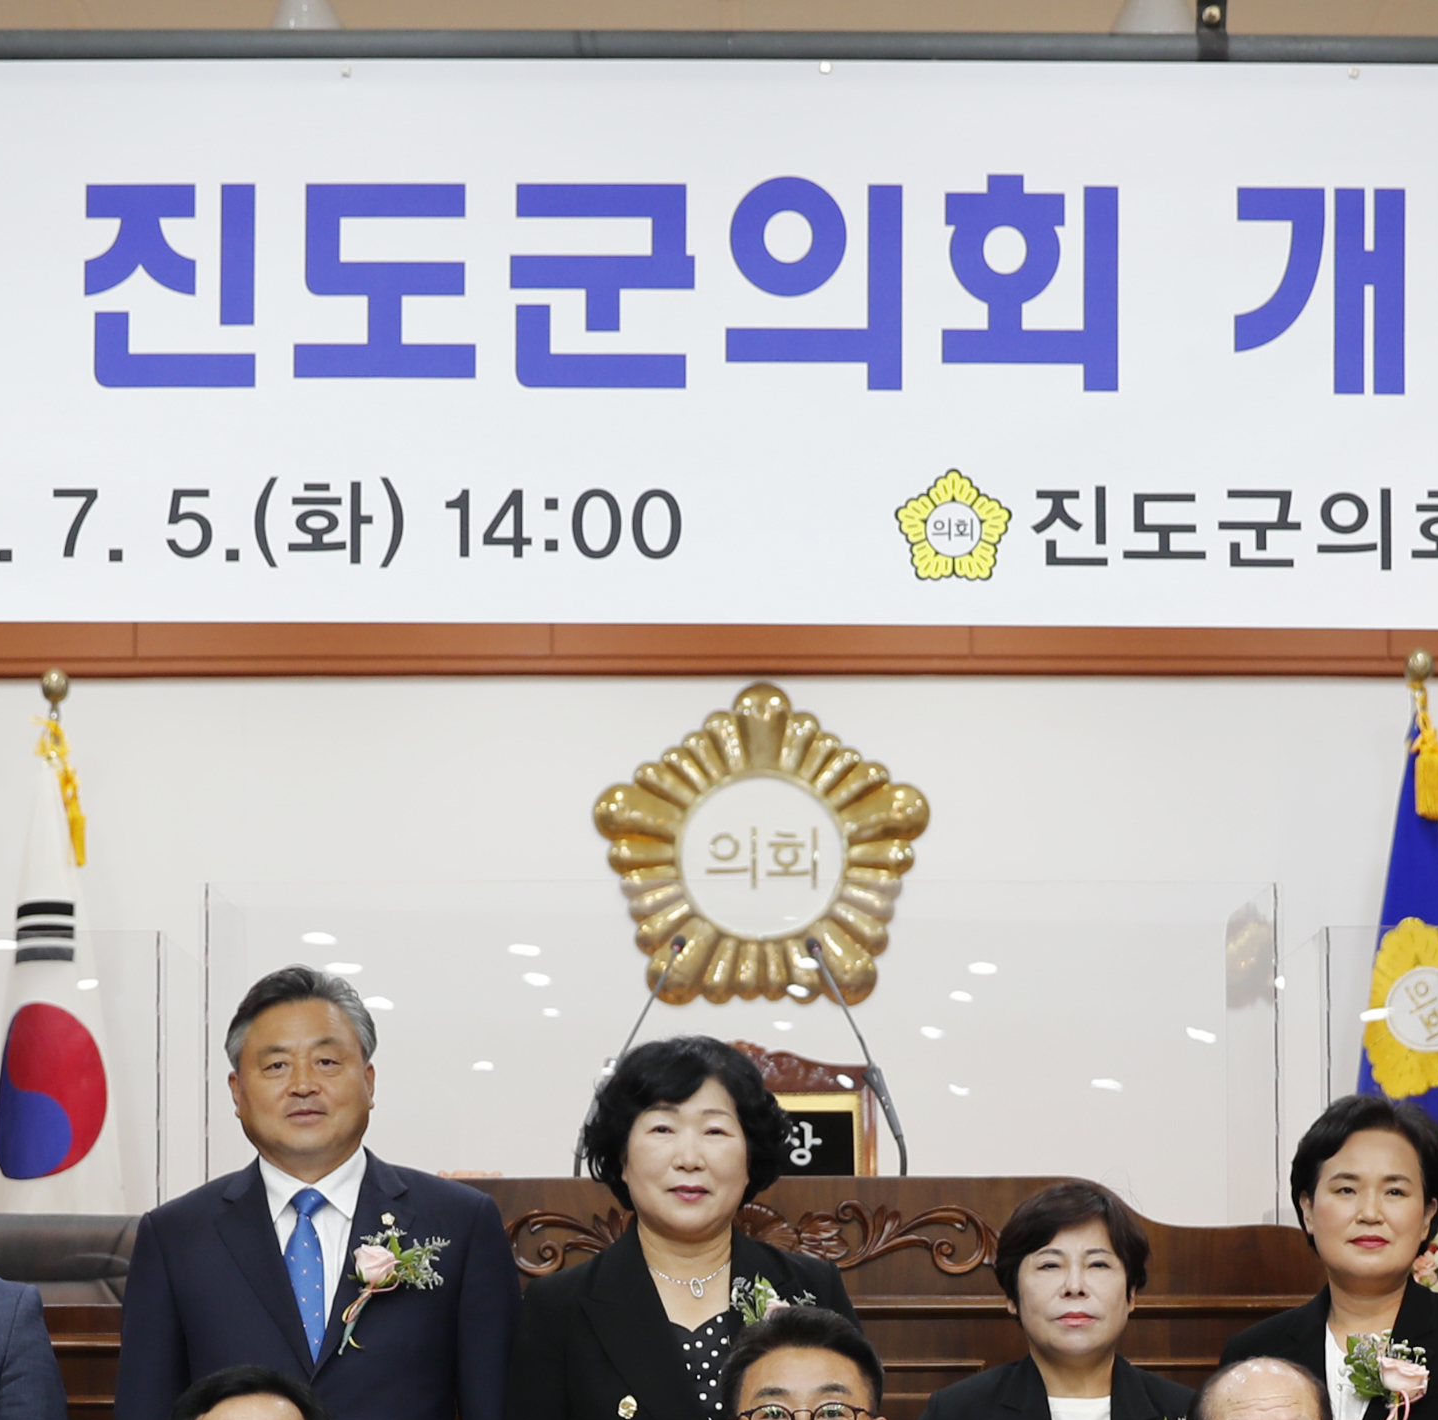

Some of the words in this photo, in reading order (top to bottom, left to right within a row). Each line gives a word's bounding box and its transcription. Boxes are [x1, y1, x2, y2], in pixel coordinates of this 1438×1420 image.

[83, 174, 1120, 394] 진도군의회
[52, 488, 124, 563] 7.
[165, 477, 405, 569] 5.(화)
[445, 488, 682, 562] 14:00
[931, 517, 974, 541] 의회
[705, 826, 820, 890] 의회
